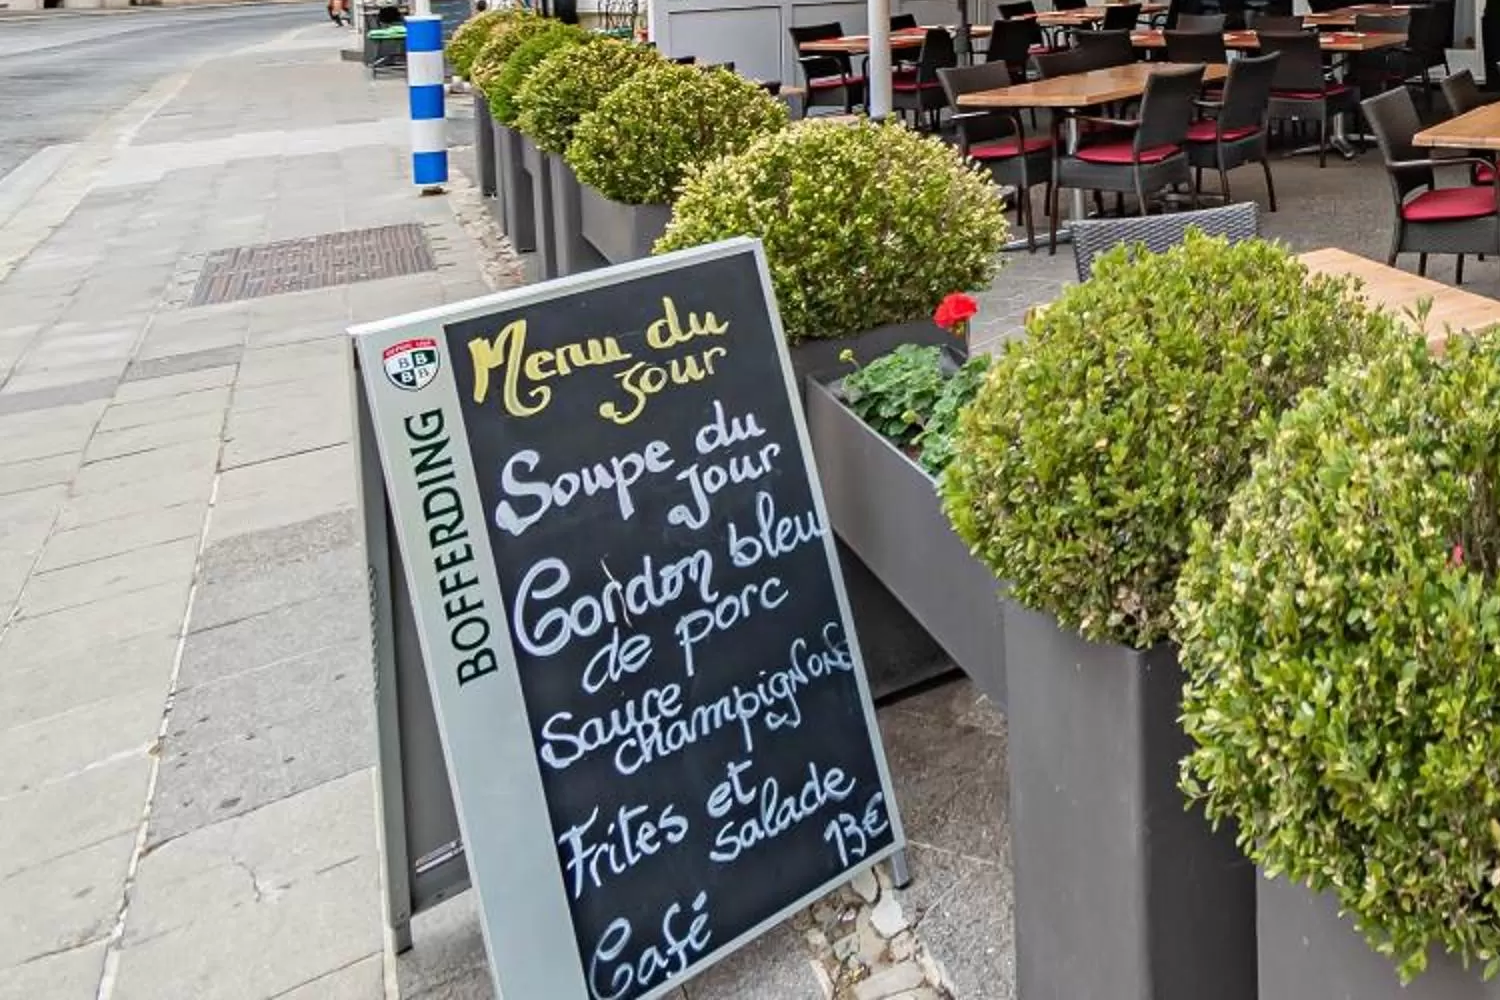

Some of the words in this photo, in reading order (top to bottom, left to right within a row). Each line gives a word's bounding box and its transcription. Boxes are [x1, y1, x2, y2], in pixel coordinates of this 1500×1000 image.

[467, 319, 632, 417] Menu
[646, 296, 729, 349] du
[495, 440, 675, 537] Soupe
[695, 400, 766, 454] du
[404, 407, 498, 687] BOFFERDING
[728, 491, 829, 567] bleu
[582, 626, 652, 694] de
[675, 578, 789, 677] porc
[541, 683, 682, 769] Sauce
[559, 805, 689, 900] Frites
[707, 760, 757, 818] et
[590, 891, 712, 1000] Café
